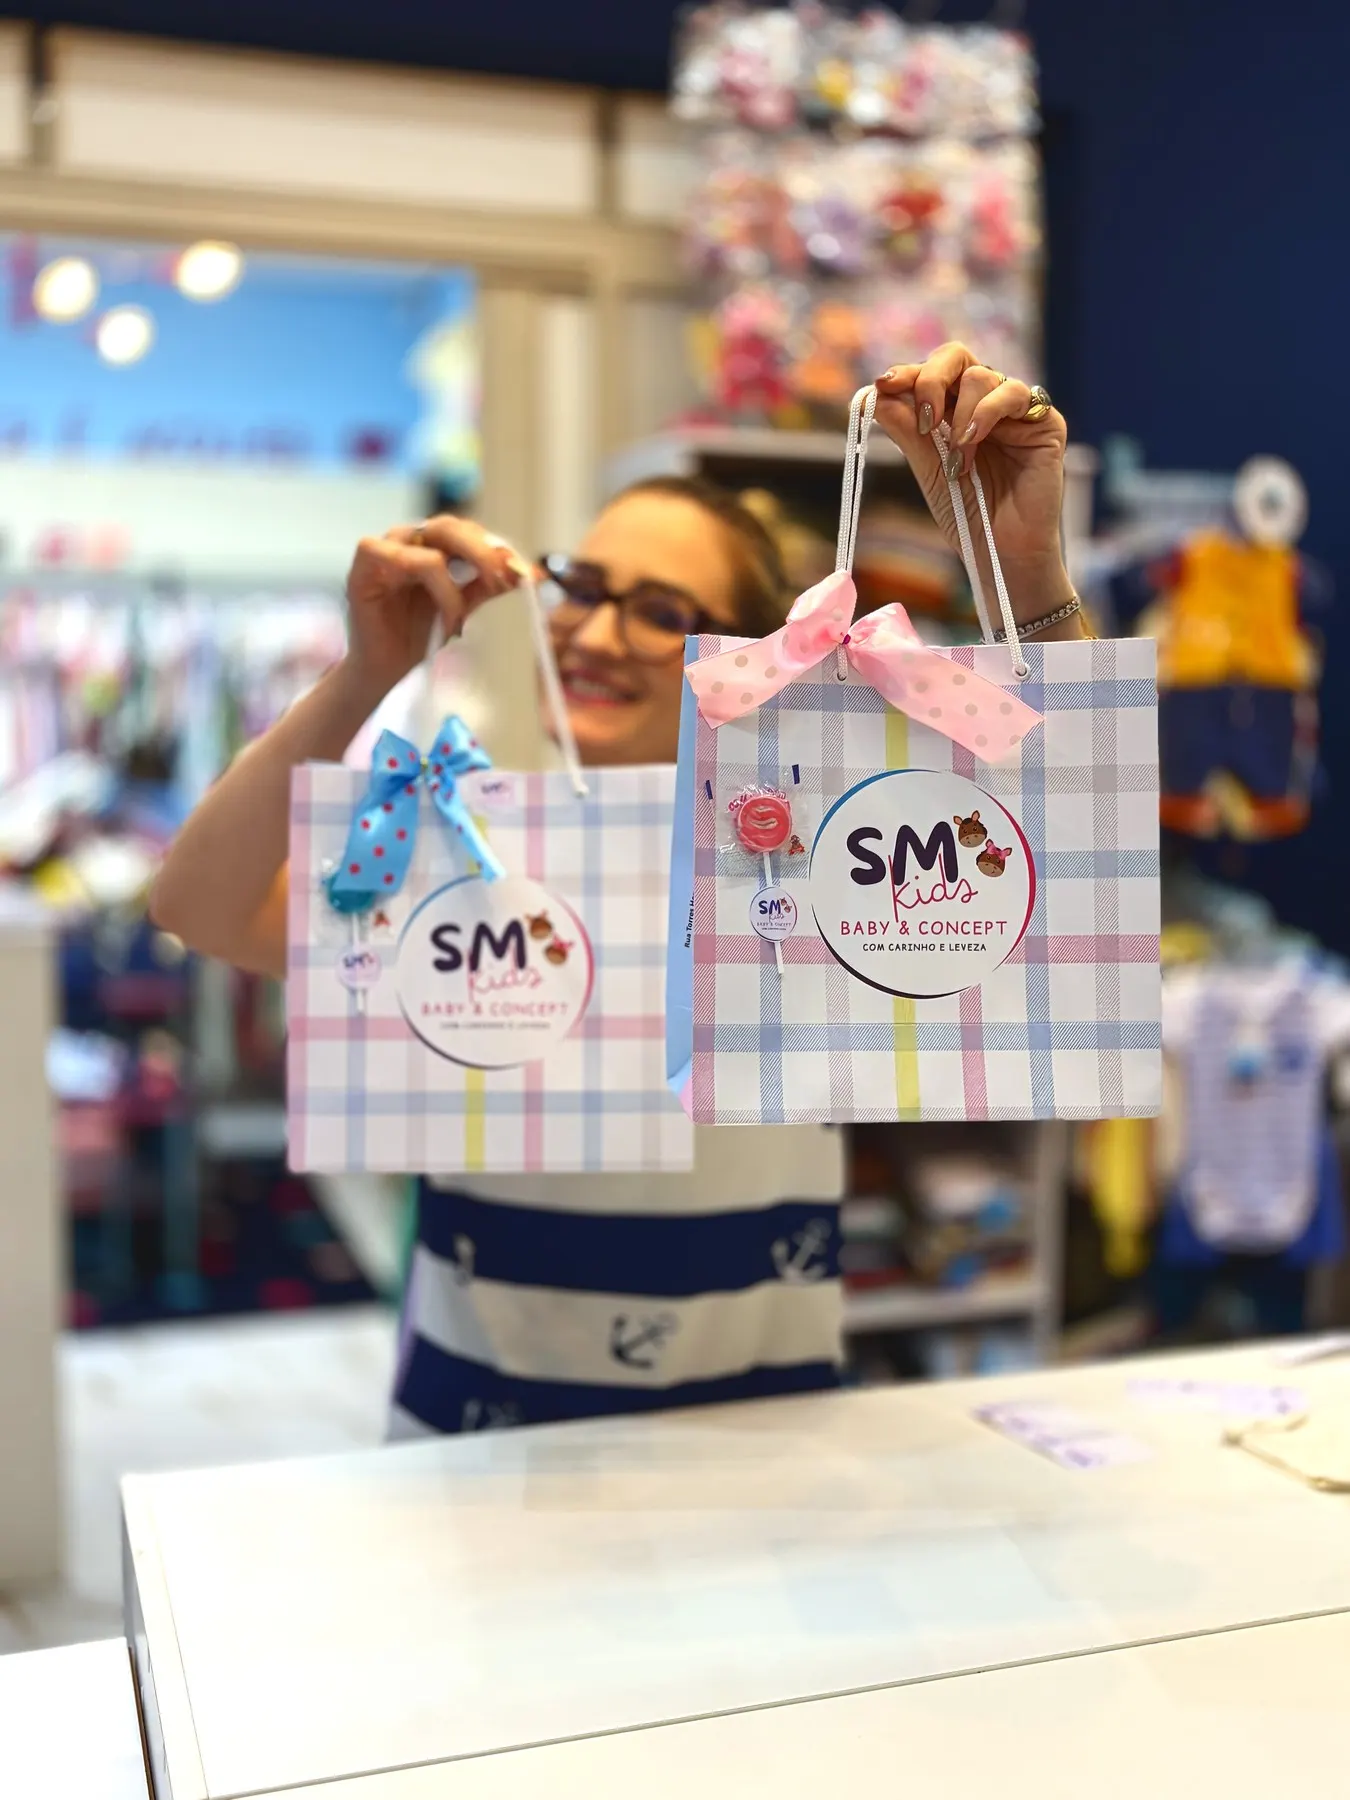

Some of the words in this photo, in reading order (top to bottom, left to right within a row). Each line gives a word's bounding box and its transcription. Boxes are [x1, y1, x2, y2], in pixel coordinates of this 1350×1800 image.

[846, 821, 959, 886] SM
[758, 899, 781, 915] SM
[685, 908, 694, 931] Torres
[840, 921, 890, 936] BABY
[899, 920, 910, 936] &
[918, 921, 1008, 936] CONCEPT
[430, 919, 527, 973] SM
[684, 933, 692, 948] Rua
[862, 943, 885, 952] COM
[888, 943, 936, 952] CARINHO
[939, 943, 945, 952] E
[949, 943, 987, 952] LEVEZA
